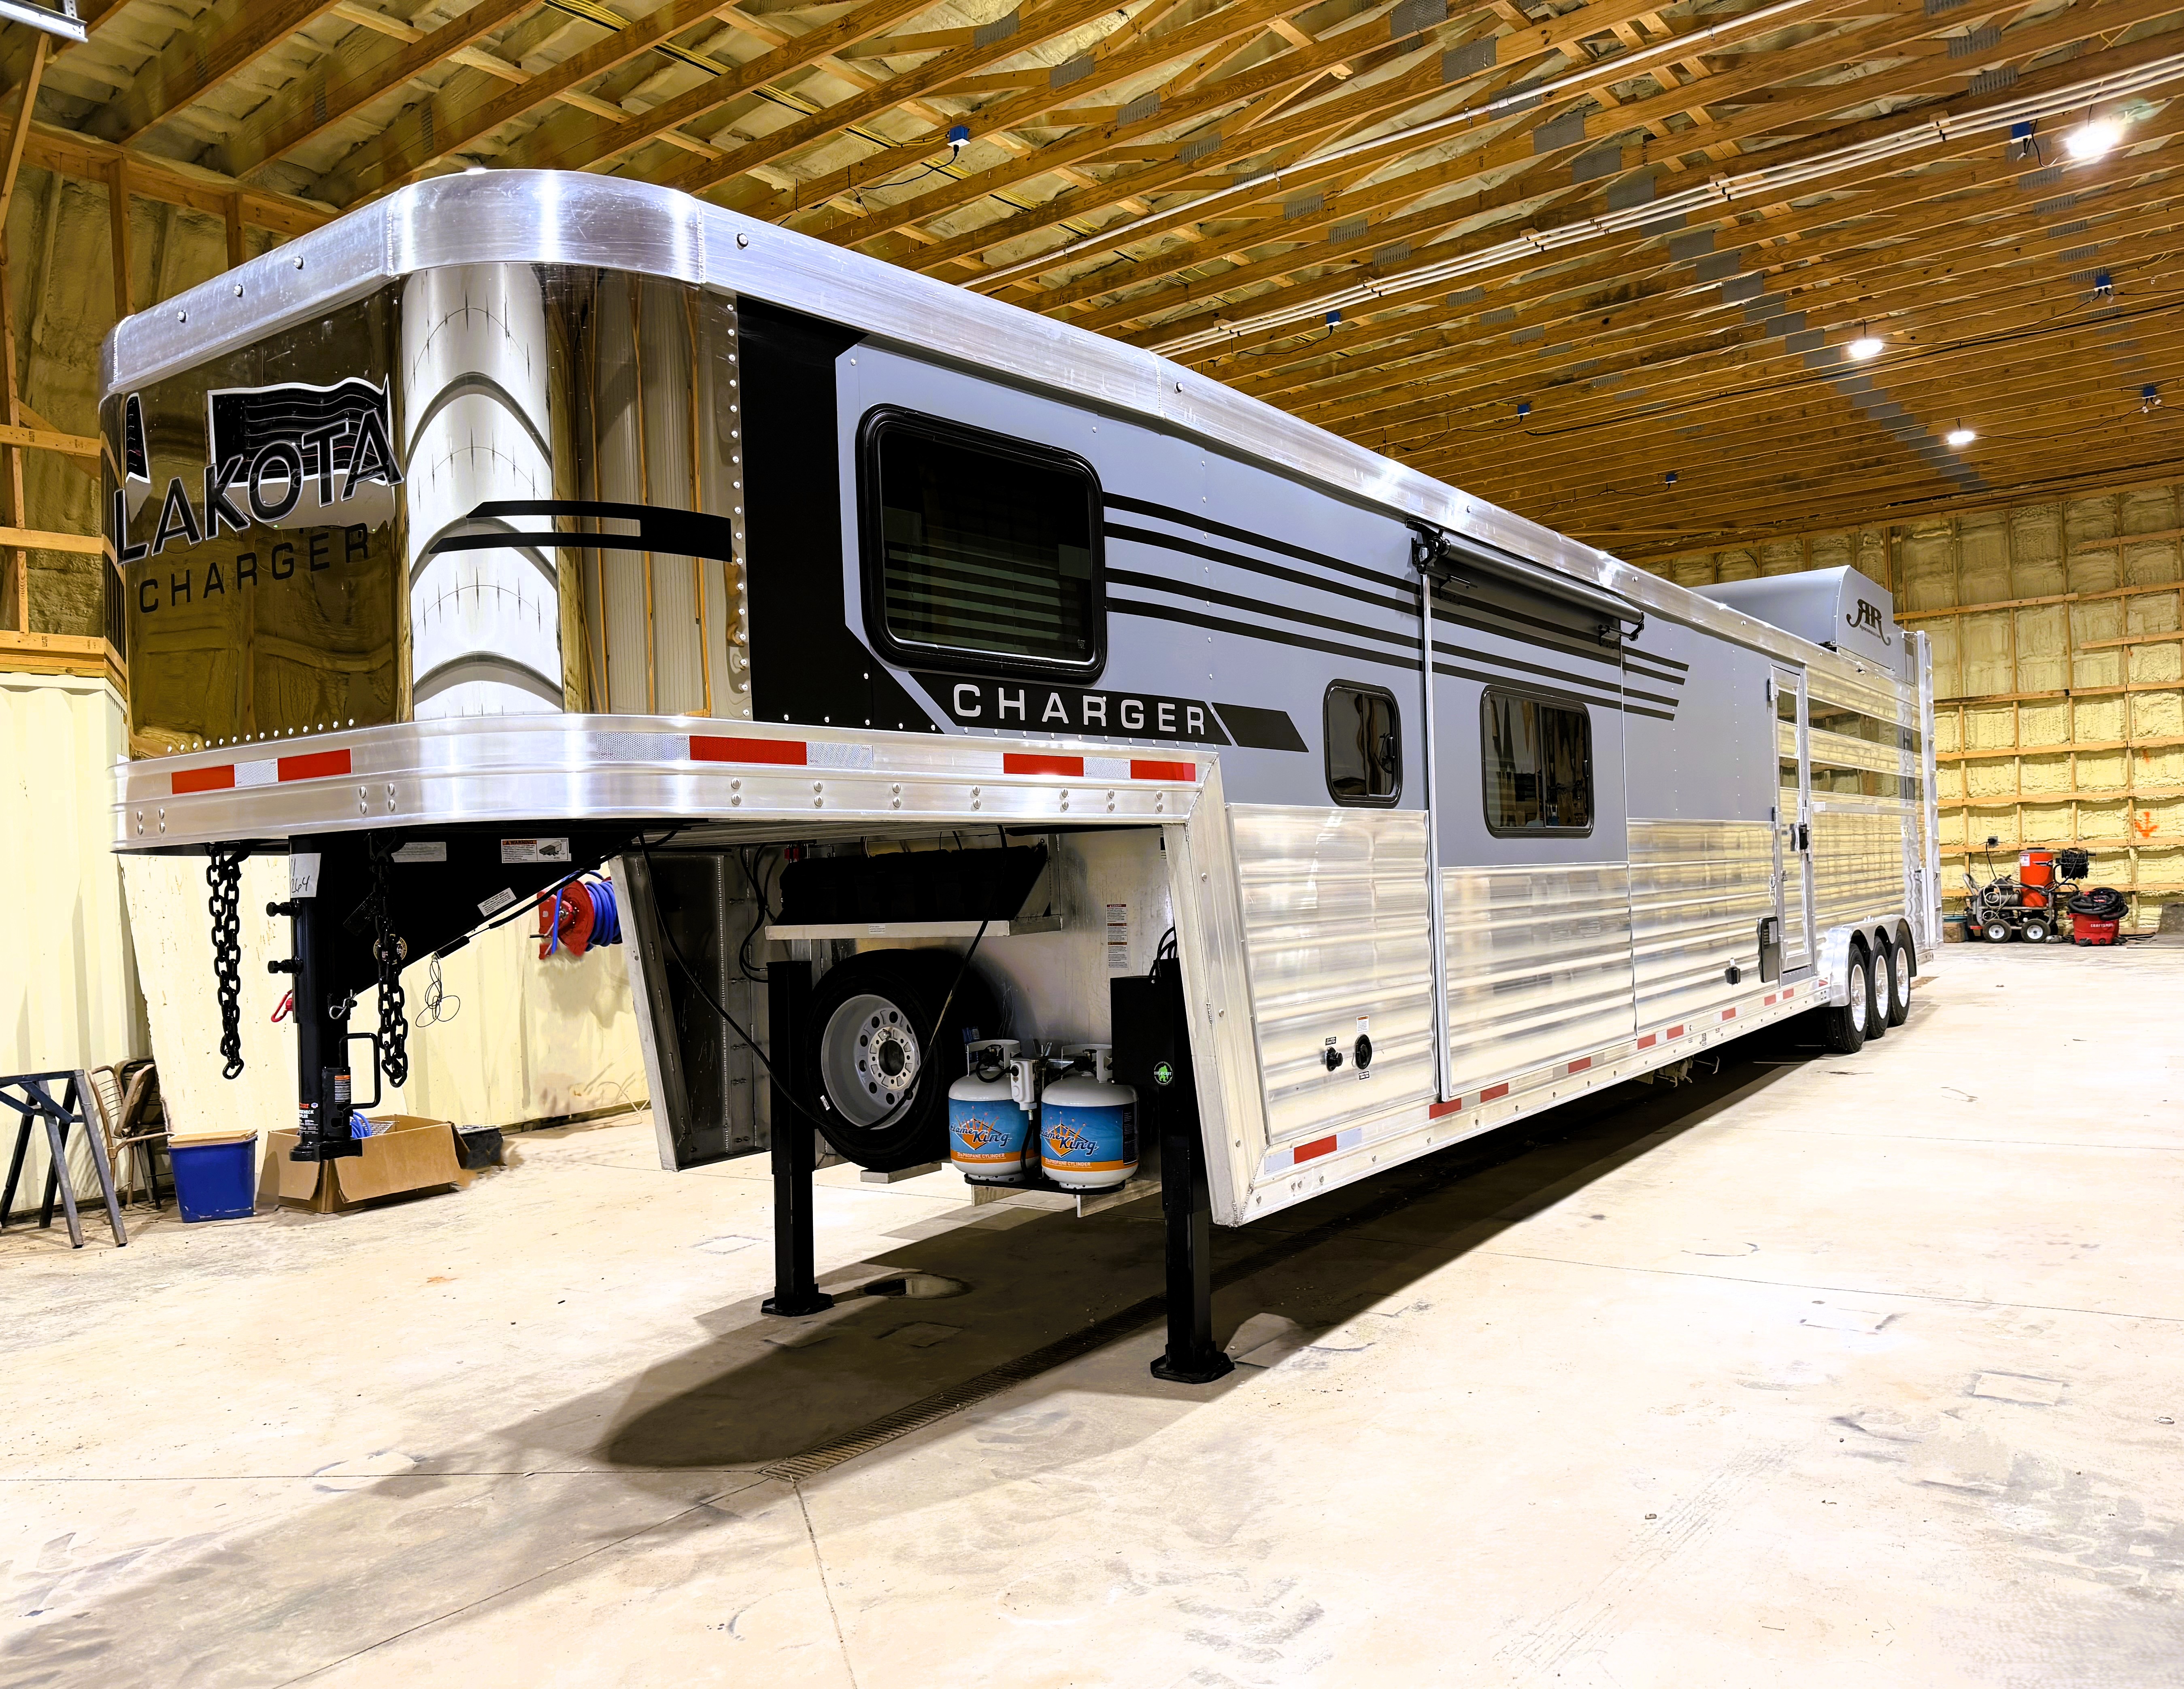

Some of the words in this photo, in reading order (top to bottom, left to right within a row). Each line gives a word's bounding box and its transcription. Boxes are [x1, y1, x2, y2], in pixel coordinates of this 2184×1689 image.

[114, 408, 404, 565] LAKOTA
[139, 523, 368, 613] CHARGER
[953, 684, 1204, 735] CHARGER
[950, 1123, 974, 1134] Flame
[972, 1129, 1012, 1147] King
[1059, 1136, 1099, 1156] King
